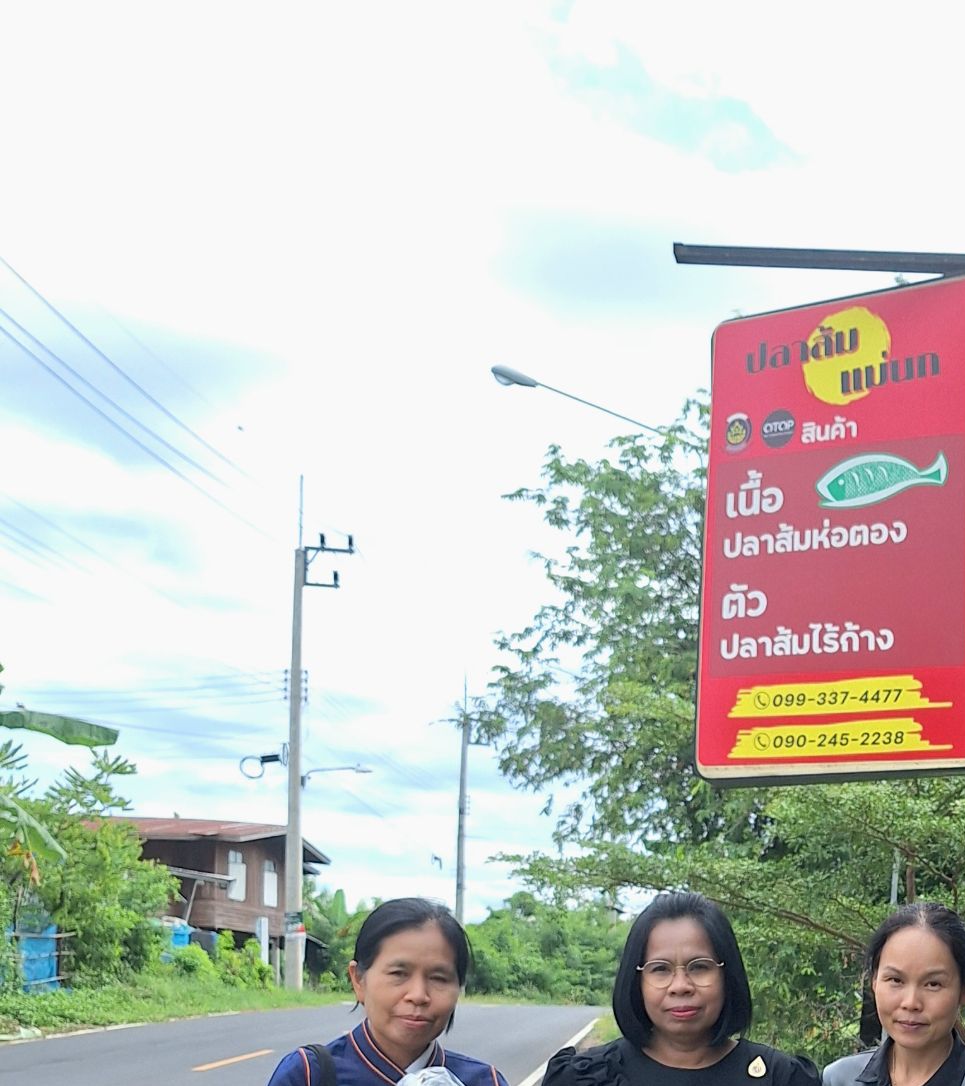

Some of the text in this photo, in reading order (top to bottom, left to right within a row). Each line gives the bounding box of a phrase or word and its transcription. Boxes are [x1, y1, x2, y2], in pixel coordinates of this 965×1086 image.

[746, 325, 859, 374] ปลาส้ม
[763, 420, 795, 435] OTOP
[801, 416, 858, 444] สินค้า
[725, 470, 784, 519] เนื้อ
[723, 519, 908, 558] ปลาส้มห่อตอง
[721, 584, 767, 619] ตัว
[720, 621, 894, 660] ปลาส้มไร้ก้าง
[772, 688, 903, 707] 099-337-4477
[773, 731, 905, 748] 090-245-2238
